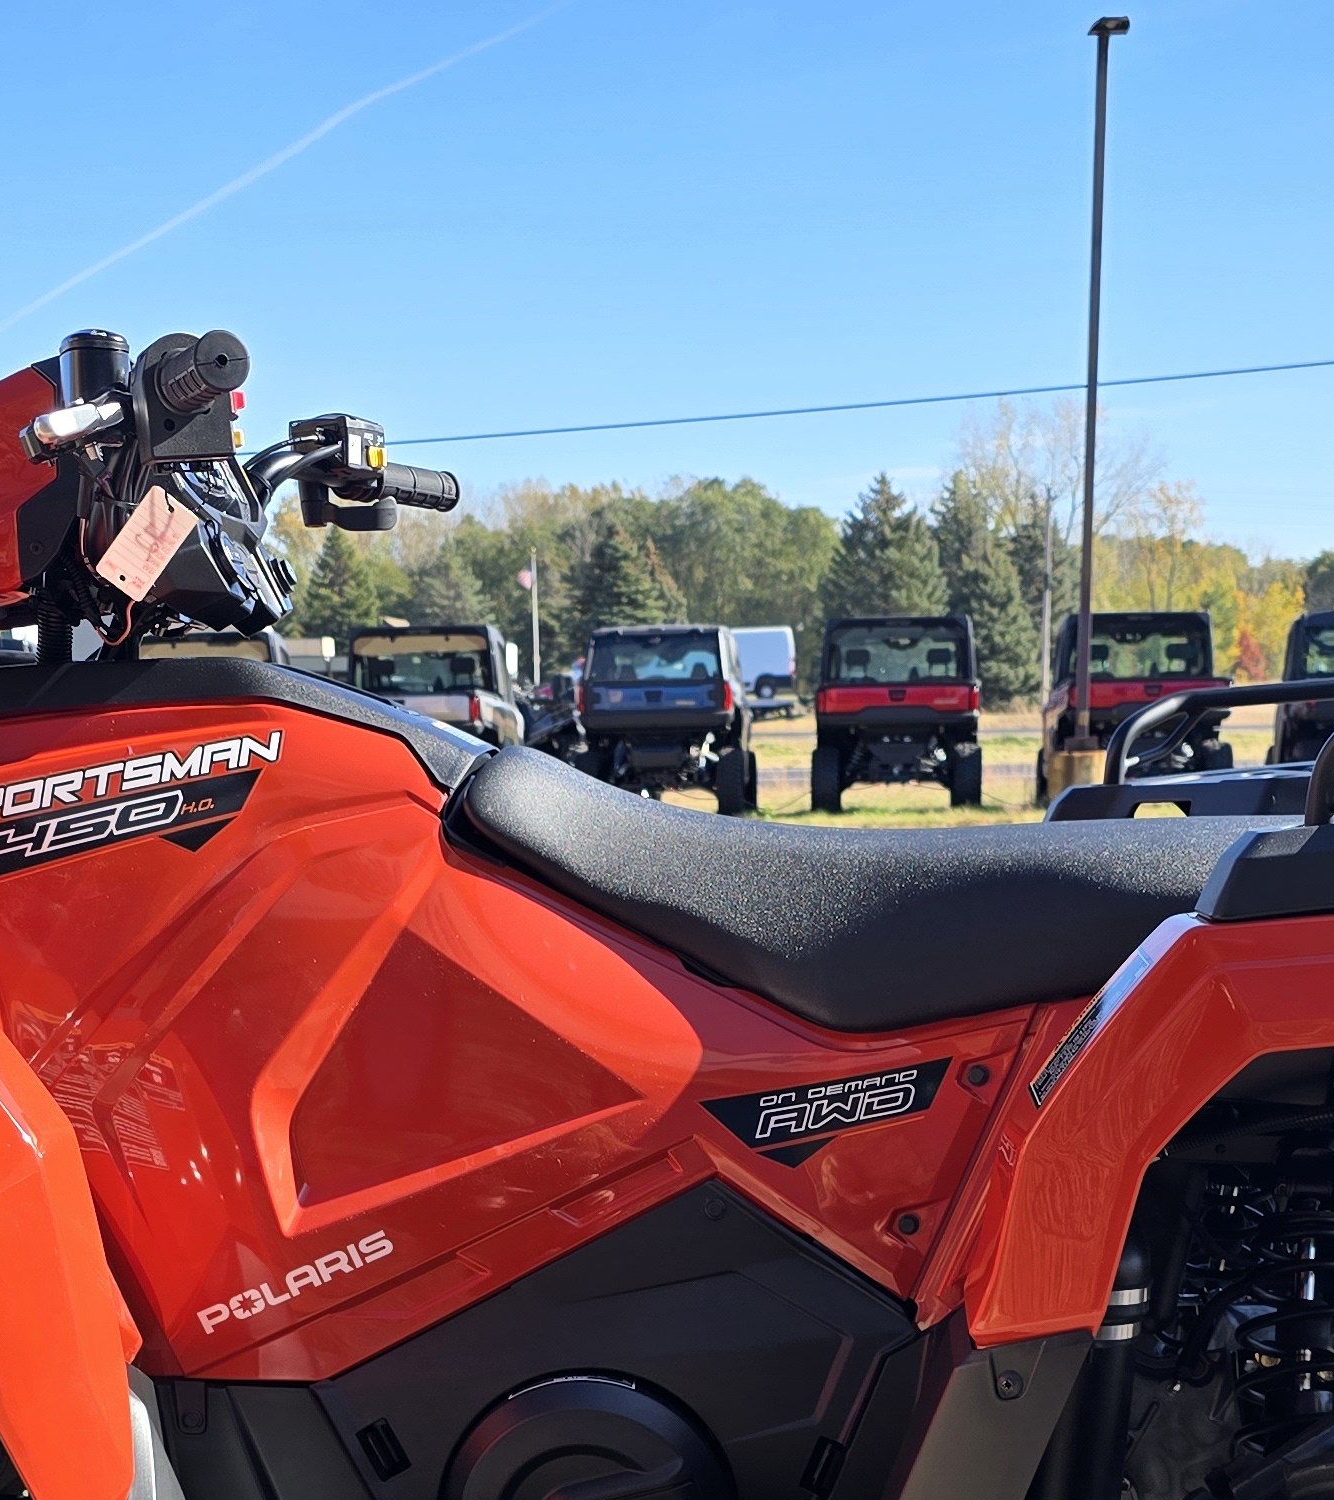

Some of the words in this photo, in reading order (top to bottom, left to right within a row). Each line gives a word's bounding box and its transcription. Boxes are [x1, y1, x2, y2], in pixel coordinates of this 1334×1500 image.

[182, 798, 215, 815] H.O.
[759, 1092, 797, 1107] ON
[807, 1070, 917, 1099] DEMAND
[755, 1085, 917, 1139] AWD
[196, 1229, 394, 1335] POLARIS
